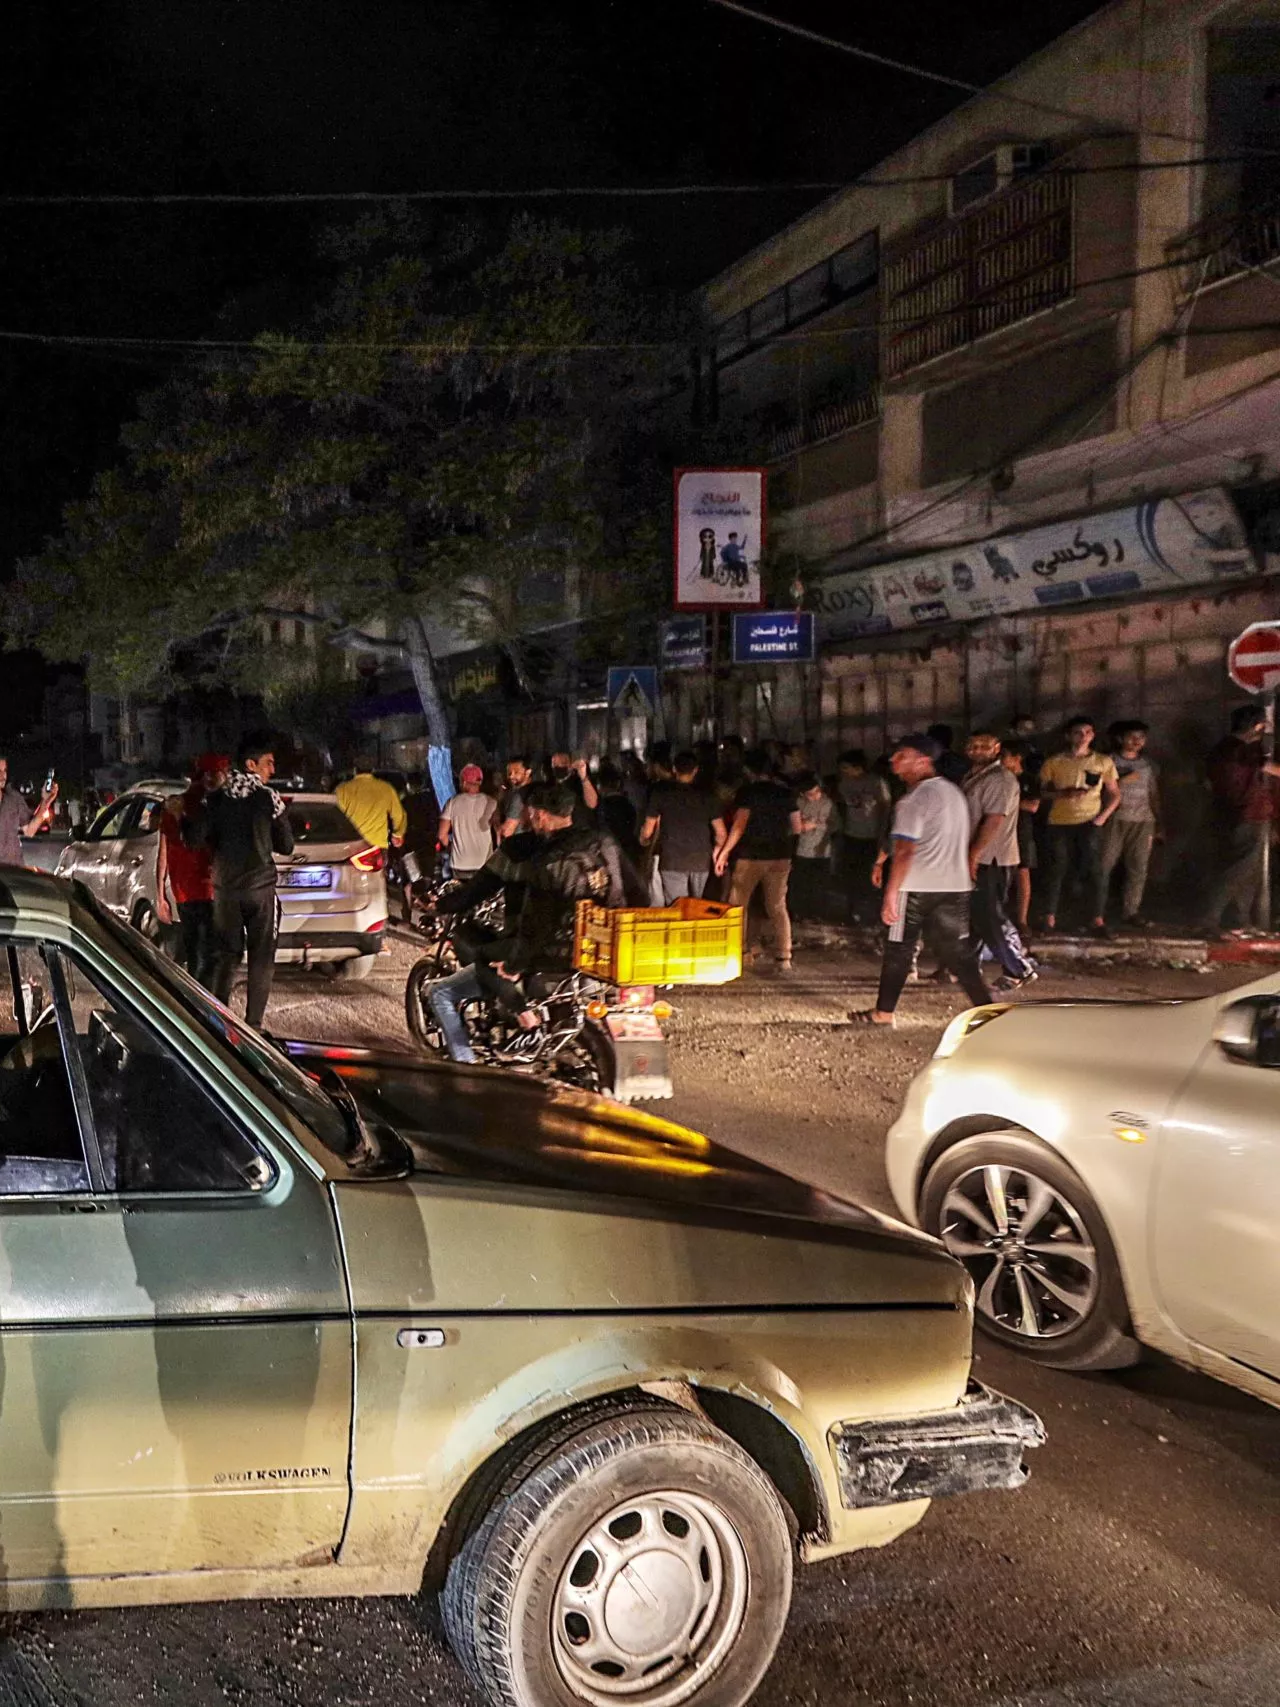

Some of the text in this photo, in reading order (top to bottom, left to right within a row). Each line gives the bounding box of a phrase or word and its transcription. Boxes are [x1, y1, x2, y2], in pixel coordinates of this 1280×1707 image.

[1032, 527, 1124, 581] روكسي
[750, 622, 799, 638] شارع فلسطين
[750, 642, 786, 652] PALESTINE
